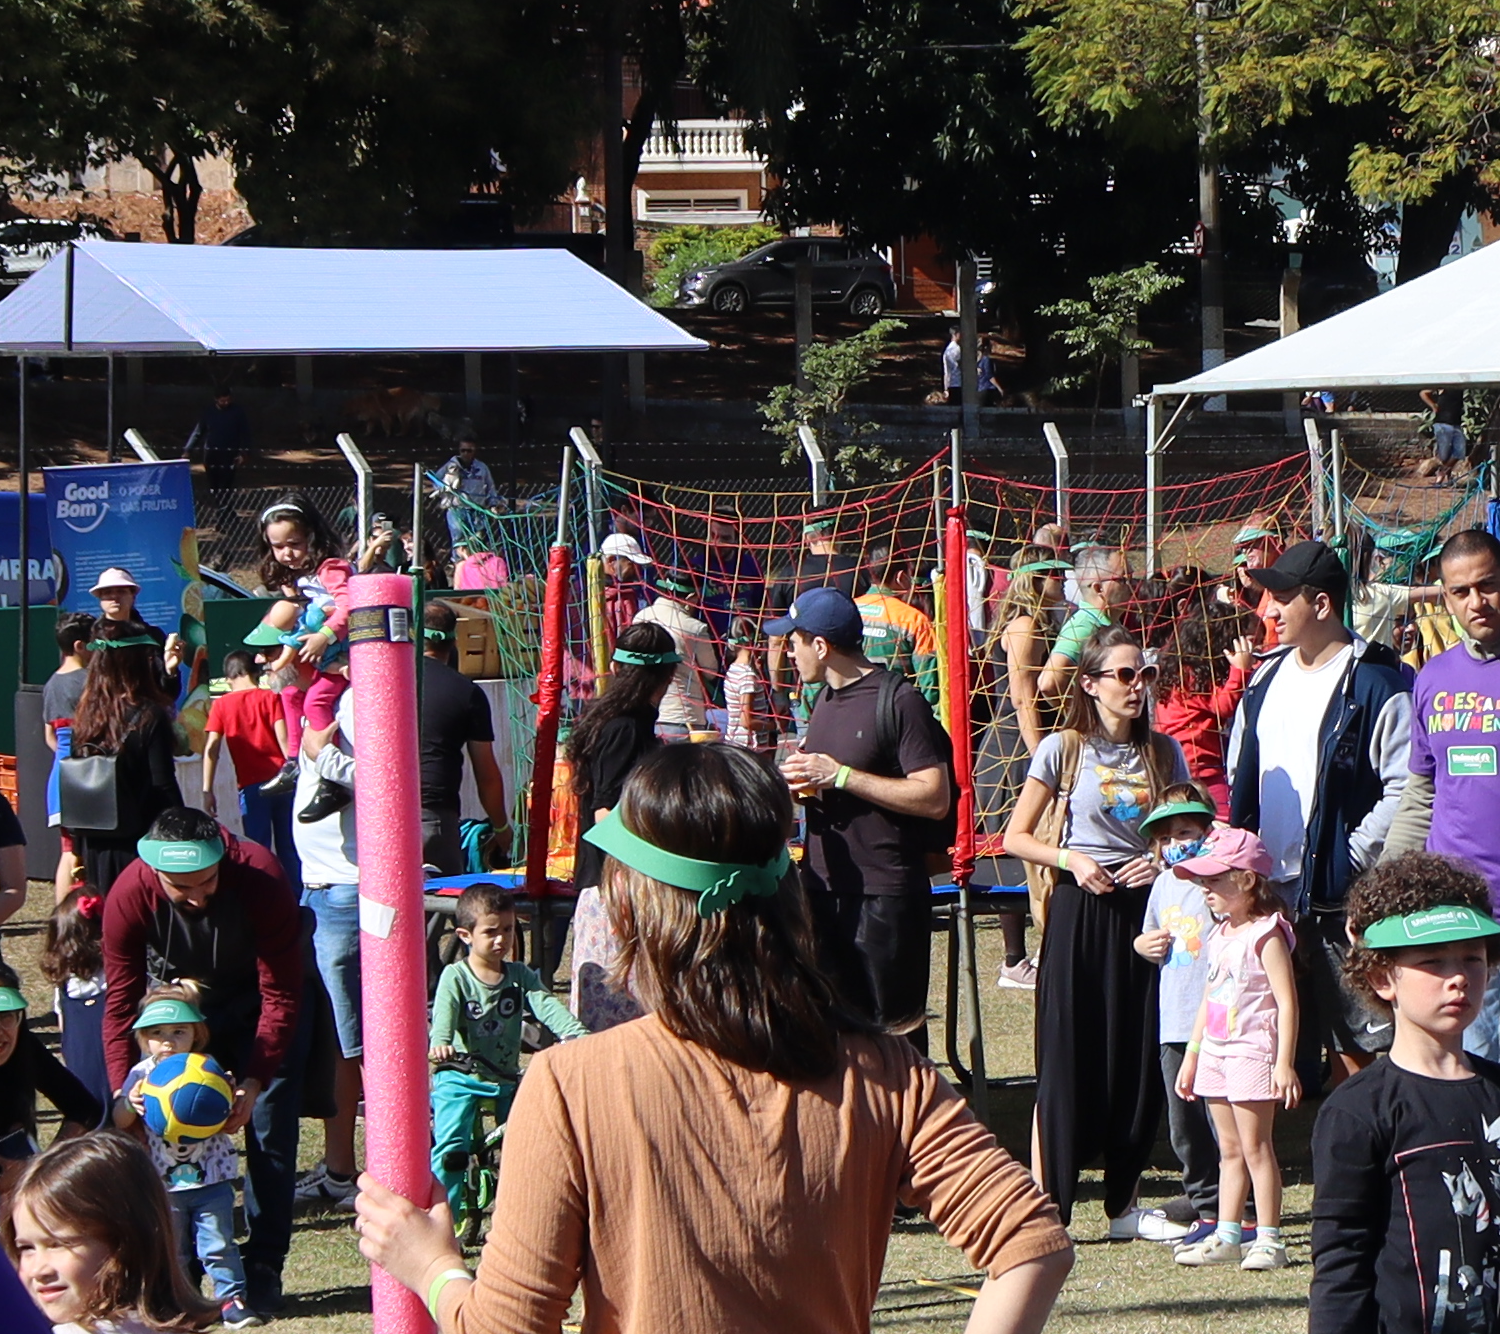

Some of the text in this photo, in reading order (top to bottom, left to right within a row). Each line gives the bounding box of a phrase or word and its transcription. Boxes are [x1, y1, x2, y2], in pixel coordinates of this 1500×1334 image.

[64, 481, 109, 501] Good
[128, 484, 161, 496] PODER
[56, 500, 97, 519] Bom
[120, 499, 177, 513] DAS FRUTAS
